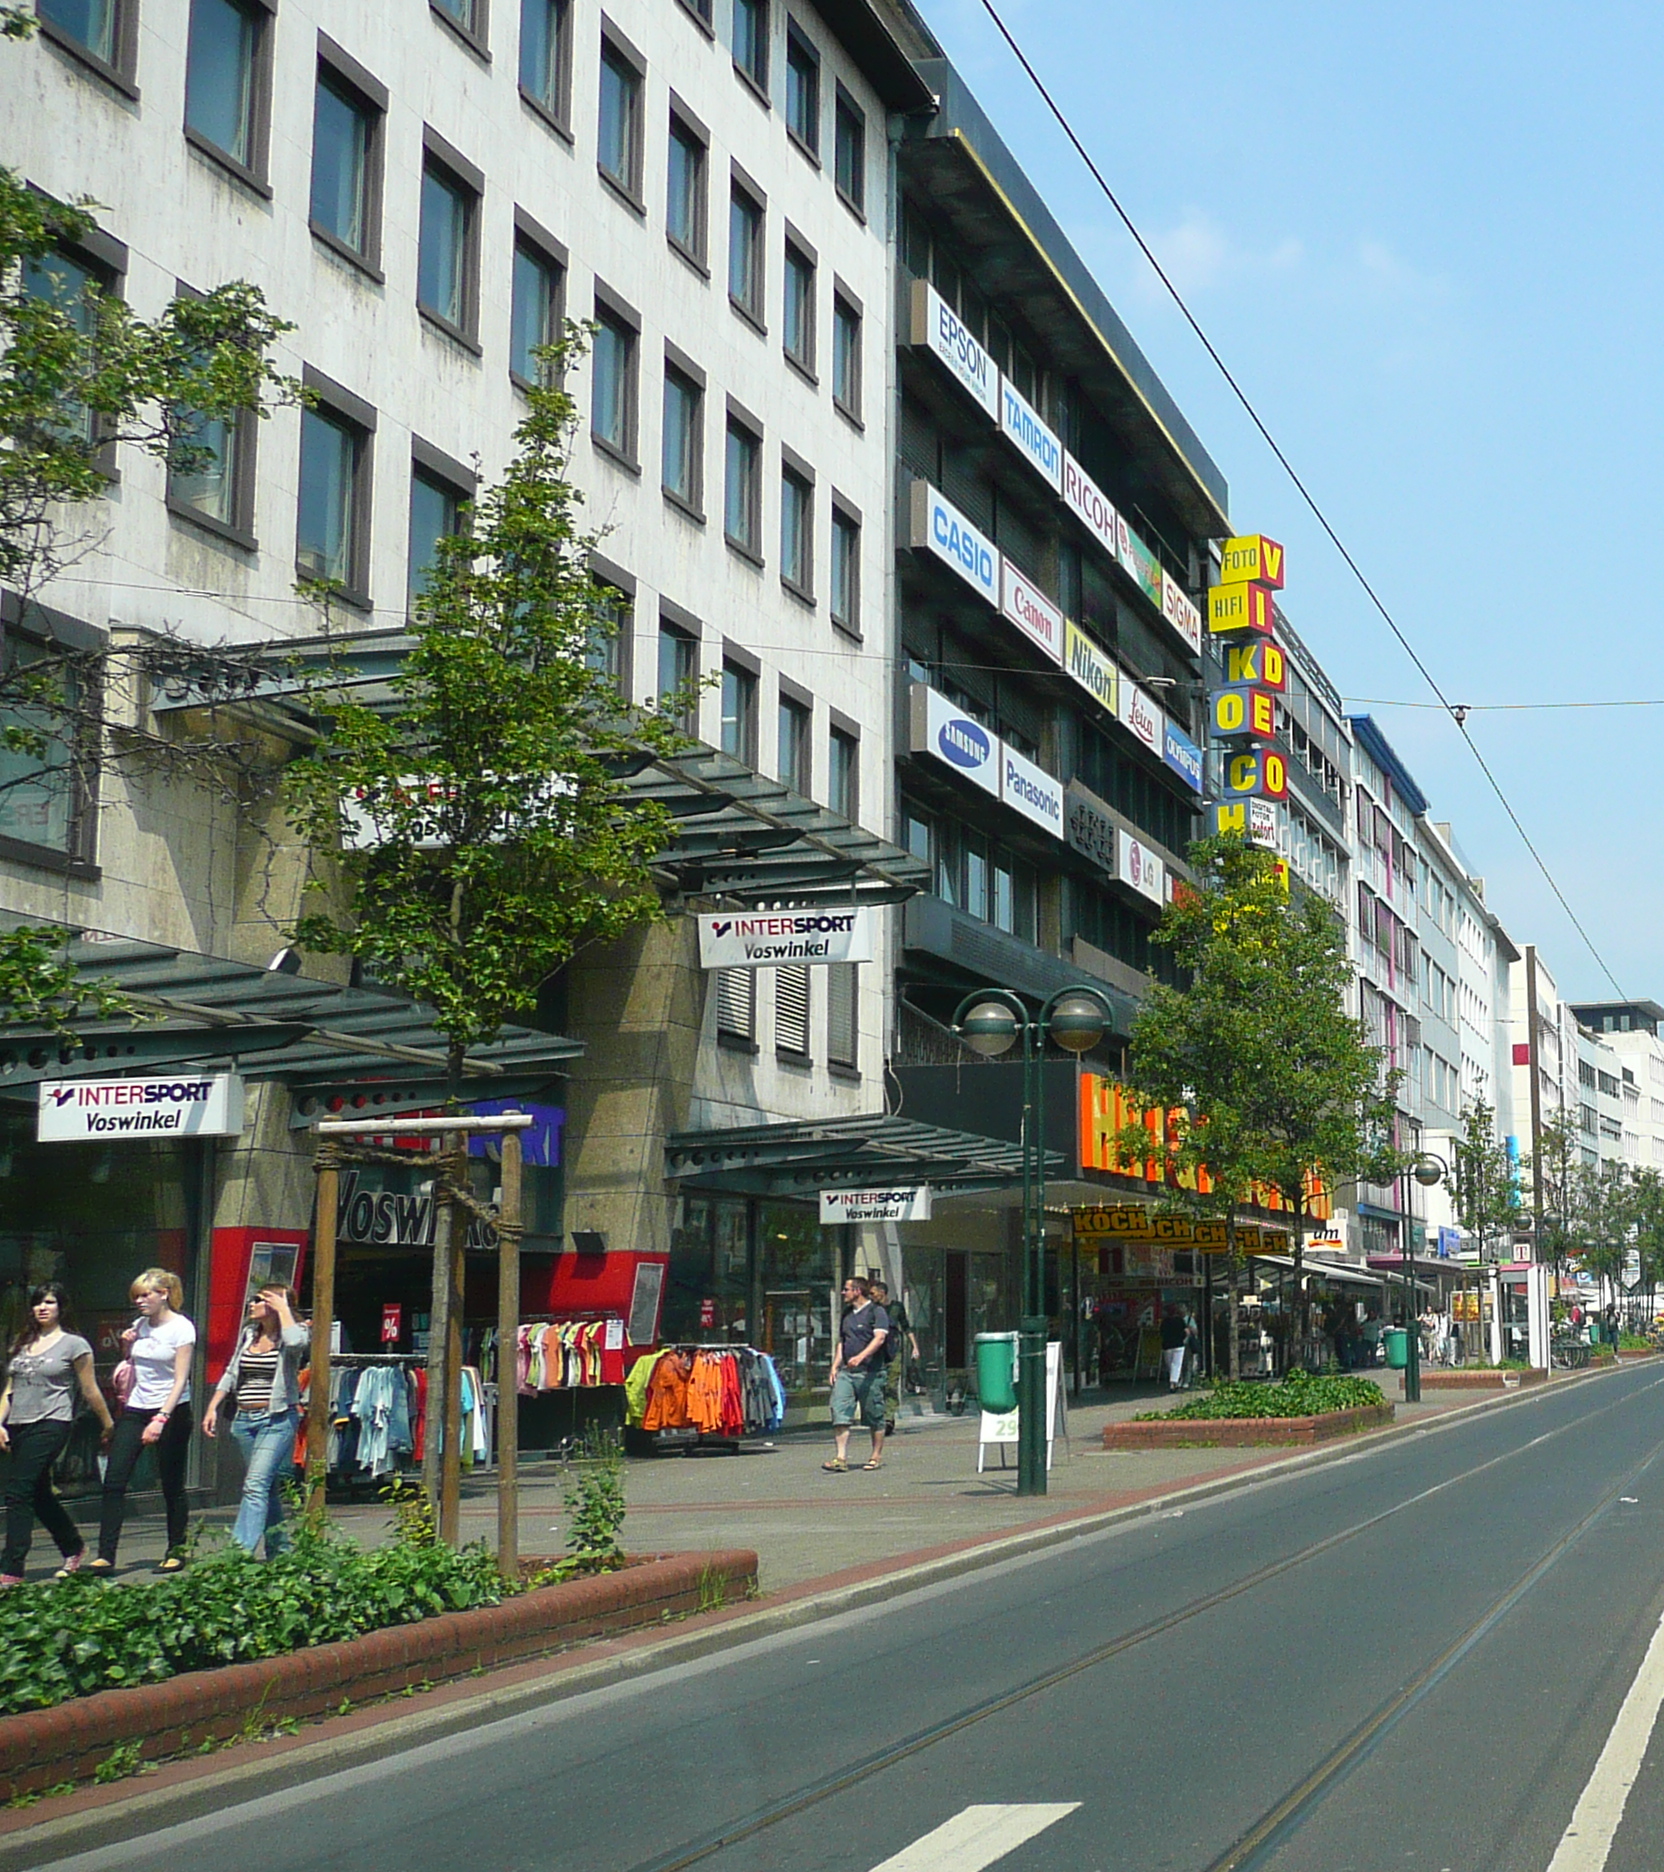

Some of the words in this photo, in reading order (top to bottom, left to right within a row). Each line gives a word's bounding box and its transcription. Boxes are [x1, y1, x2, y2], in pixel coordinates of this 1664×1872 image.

[940, 303, 986, 388] EPSON
[1003, 393, 1060, 479] TAMRON
[1065, 461, 1115, 538] RICOH
[934, 508, 993, 588] CASIO
[1224, 547, 1257, 572] FOTO
[1013, 585, 1053, 643] Canon
[1167, 584, 1198, 646] SIGMA
[1214, 595, 1243, 618] HIFI
[1071, 634, 1112, 710] Nikon
[1128, 687, 1155, 743] Leica
[944, 721, 986, 764] SAMSUNG
[1166, 733, 1201, 782] OLYMPUS
[1006, 760, 1060, 820] Panasonic
[1143, 864, 1154, 887] LG
[735, 914, 854, 937] INTERSPORT
[744, 939, 829, 960] Voswinkel
[78, 1081, 212, 1105] INTERSPORT
[86, 1109, 181, 1133] Voswinkel
[840, 1191, 916, 1205] INTERSPORT
[845, 1207, 899, 1220] Voswinkel
[1074, 1211, 1149, 1232] KOCH
[1516, 1248, 1528, 1261] T
